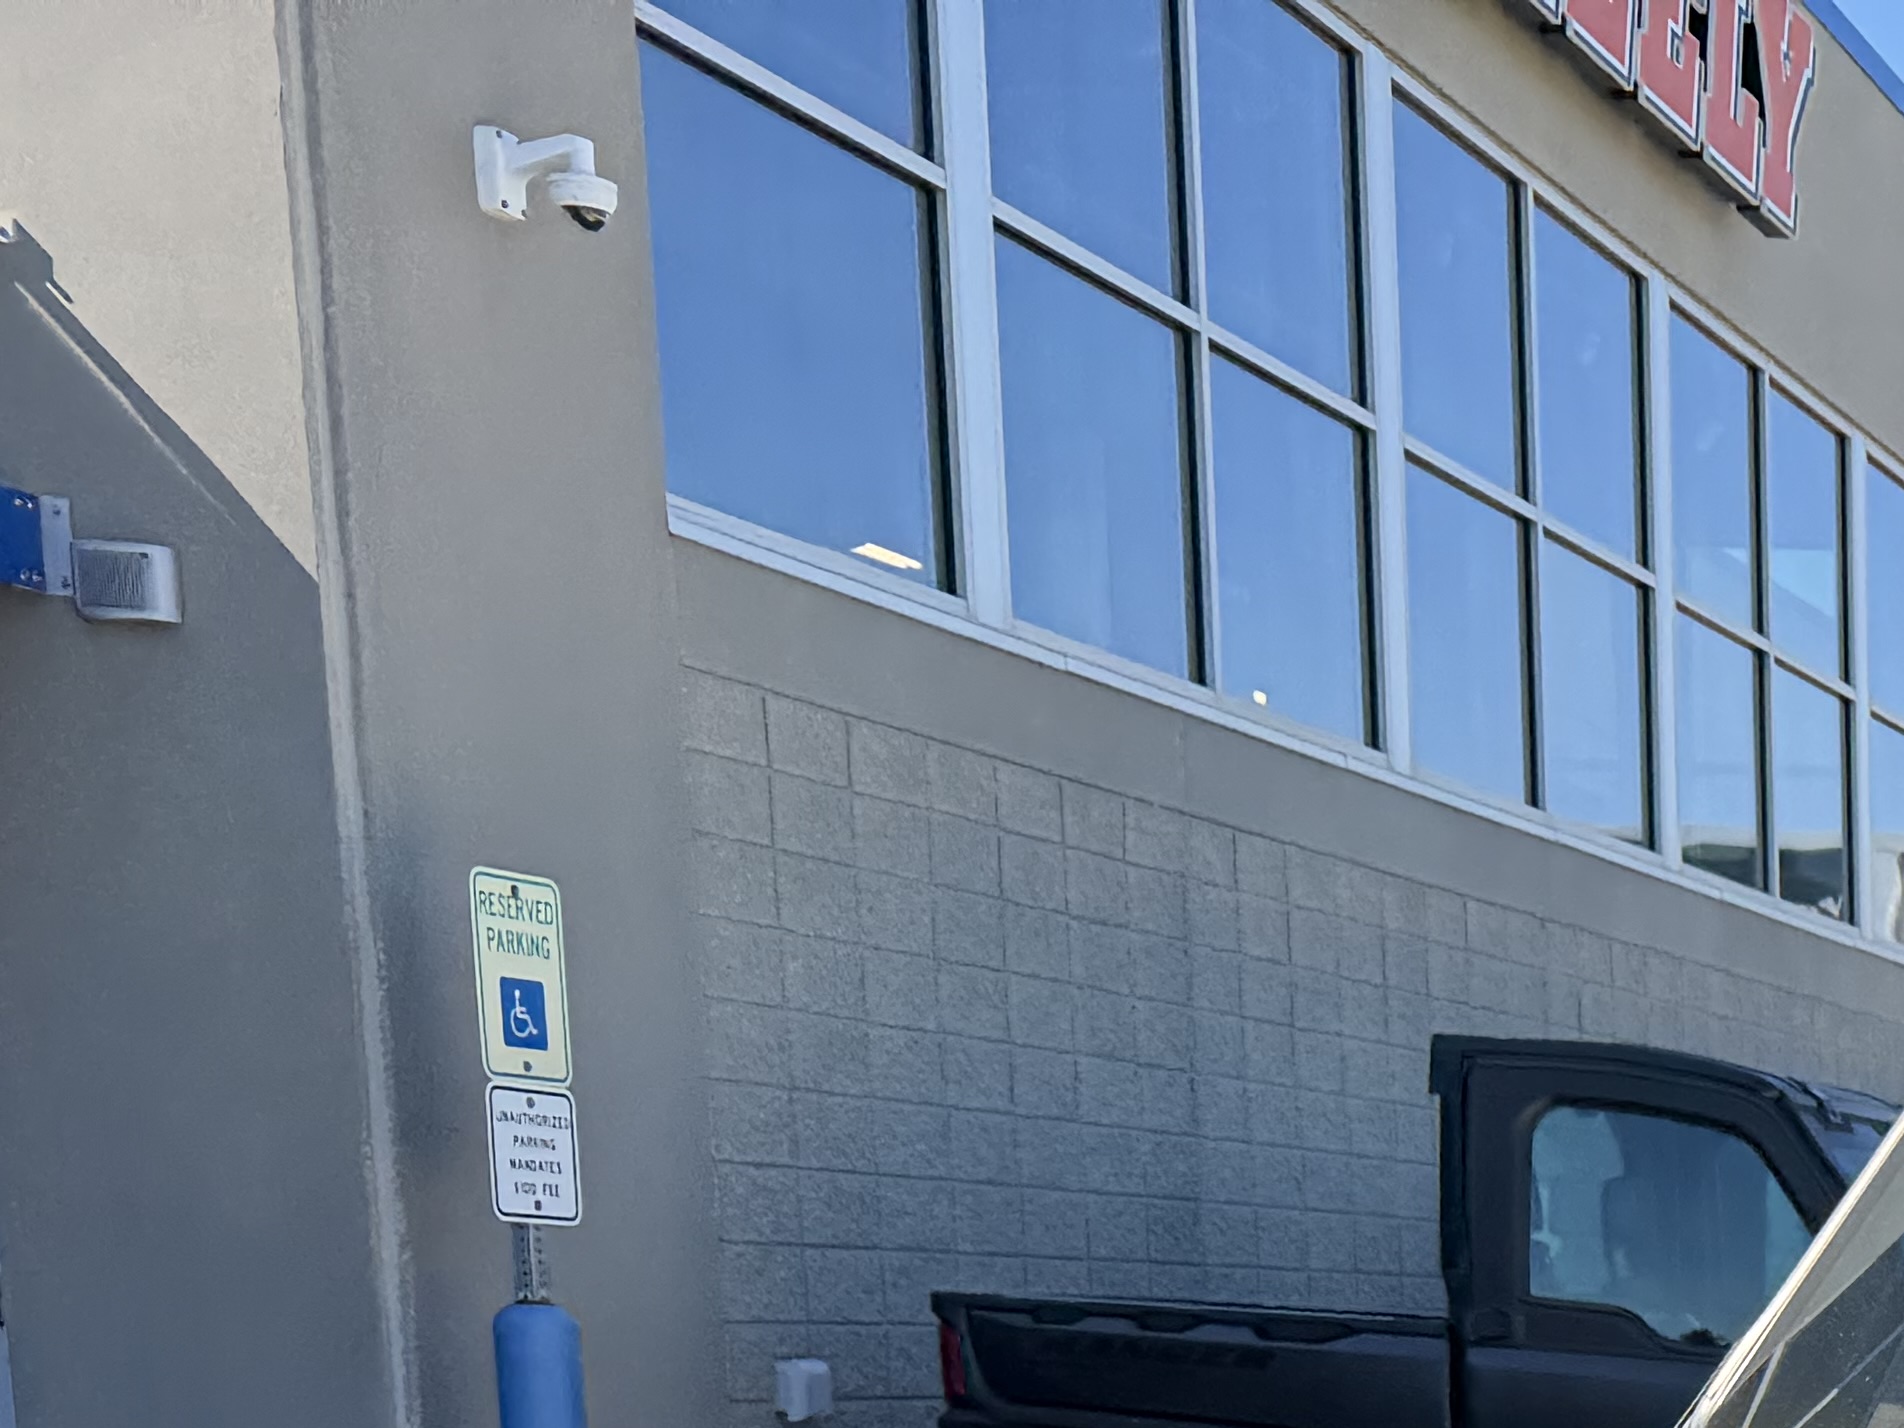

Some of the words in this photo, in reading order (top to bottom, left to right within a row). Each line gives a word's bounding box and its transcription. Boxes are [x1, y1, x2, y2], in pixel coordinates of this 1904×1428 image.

[478, 889, 554, 926] RESERVED
[486, 926, 550, 960] PARKING
[512, 1134, 556, 1151] PARKING
